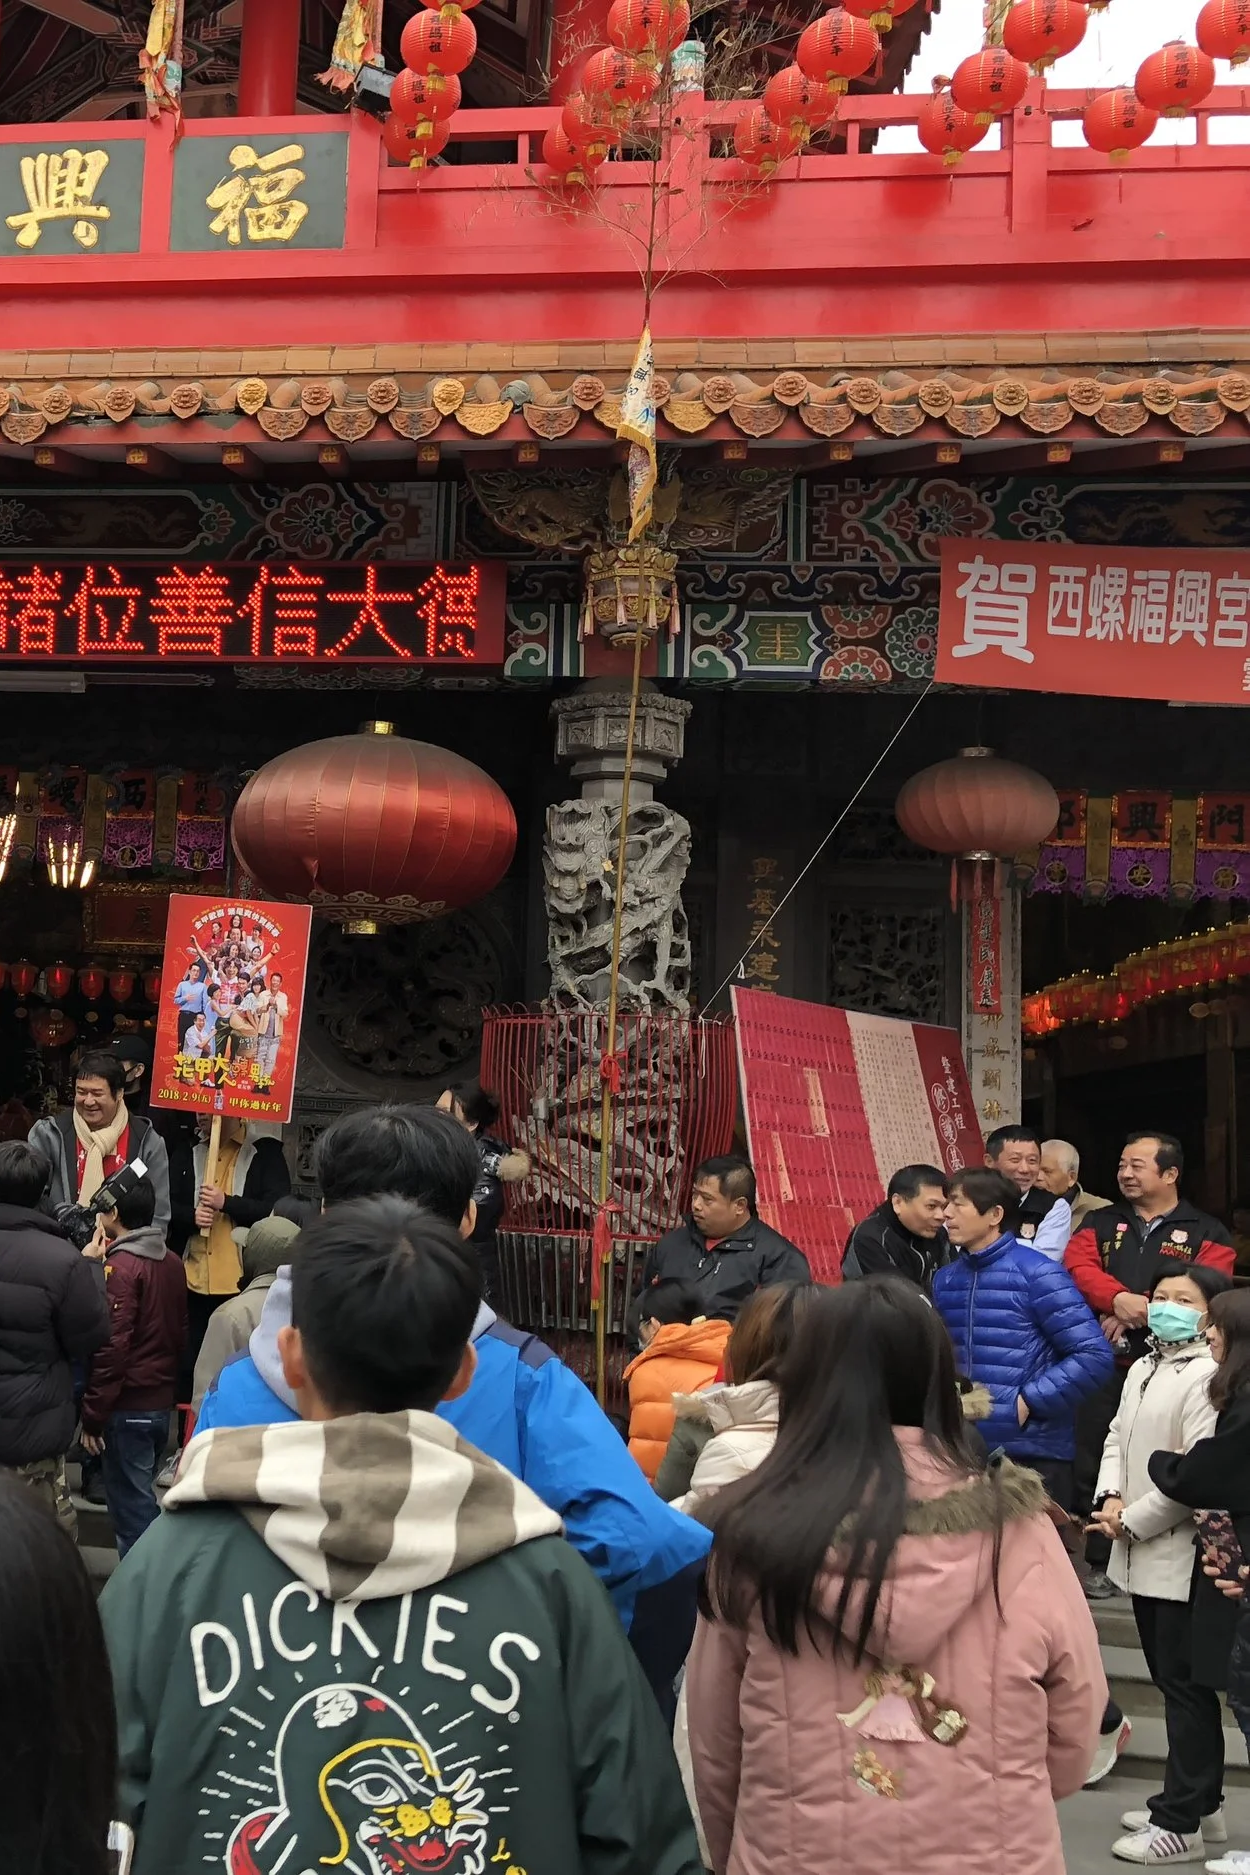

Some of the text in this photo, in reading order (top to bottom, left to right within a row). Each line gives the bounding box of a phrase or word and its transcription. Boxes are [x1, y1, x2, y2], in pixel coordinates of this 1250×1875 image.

[951, 554, 1250, 664] 賀 西螺福興宮
[190, 1580, 541, 1714] DICKIES
